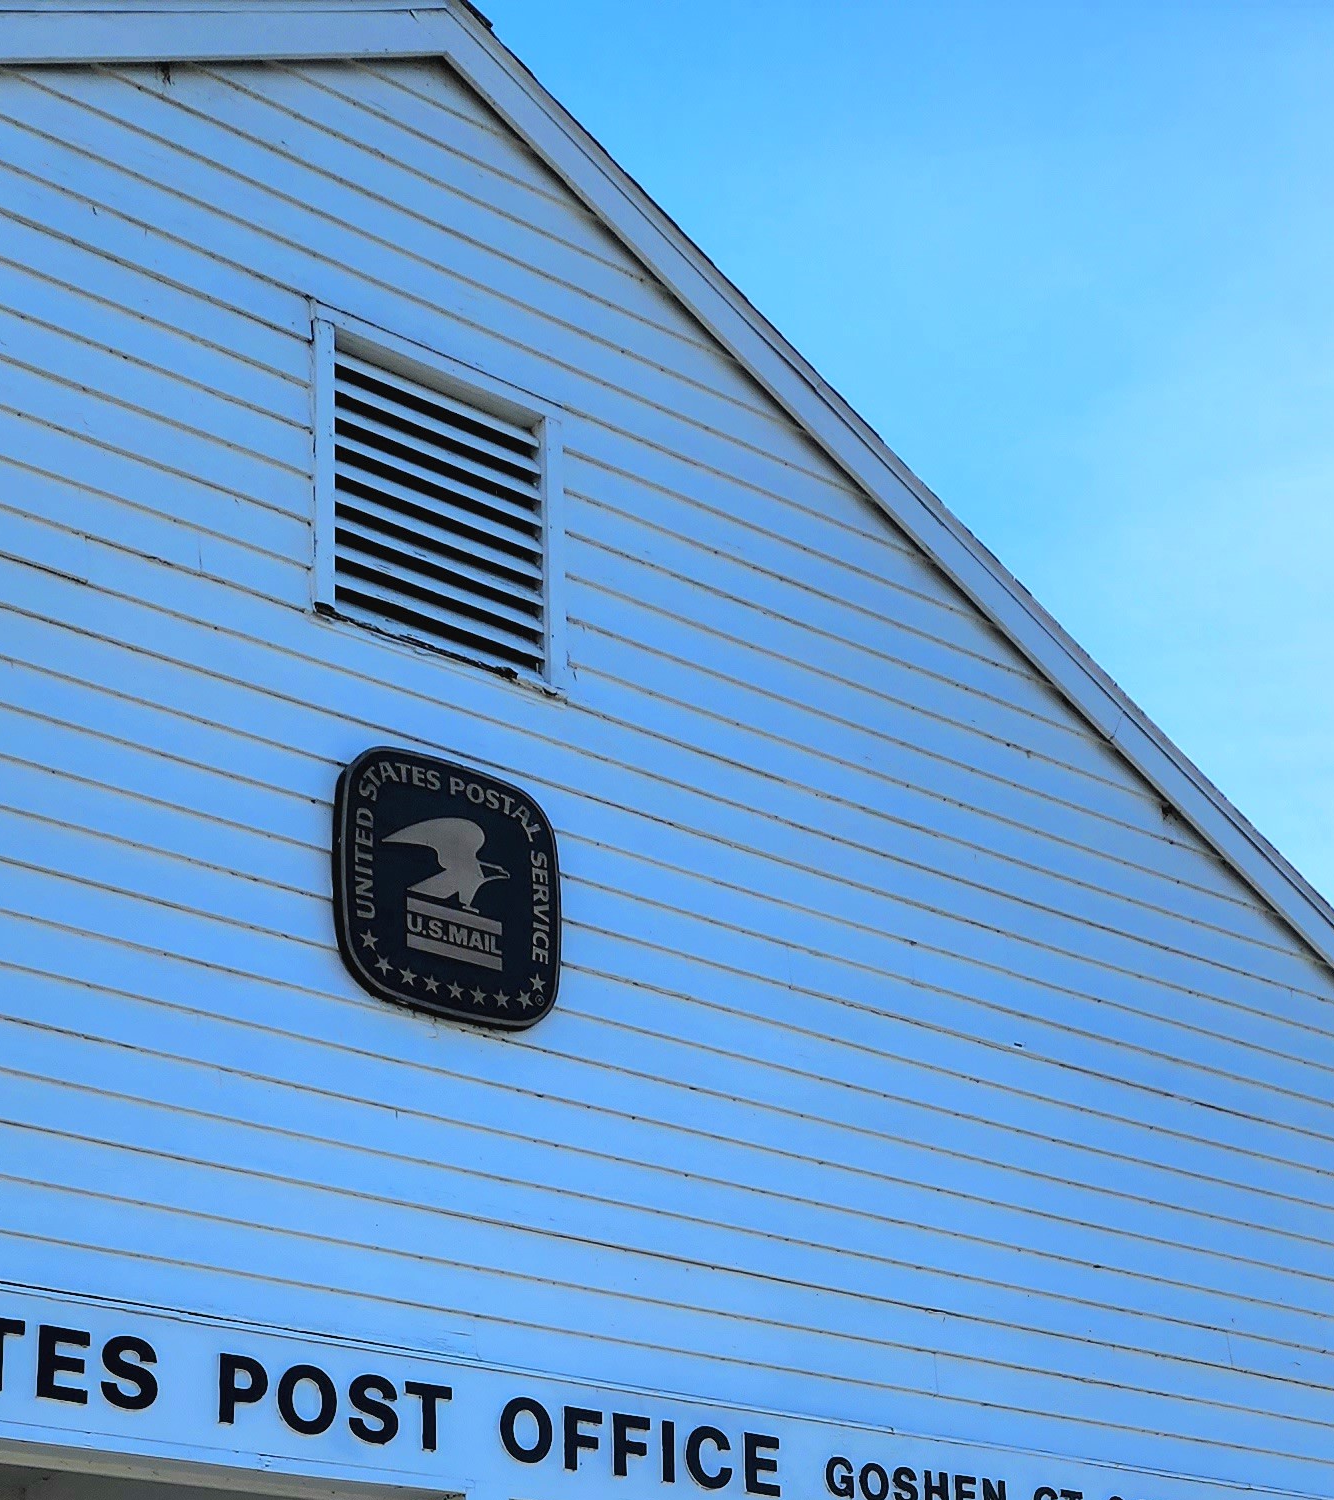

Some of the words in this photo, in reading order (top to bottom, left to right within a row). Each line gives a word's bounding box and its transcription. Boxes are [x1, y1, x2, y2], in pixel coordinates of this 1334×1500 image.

[358, 761, 441, 802] STATES
[449, 776, 542, 843] POSTAL
[354, 807, 376, 919] UNITED
[530, 850, 550, 965] SERVICE
[217, 1352, 453, 1452] POST
[498, 1396, 782, 1498] OFFICE
